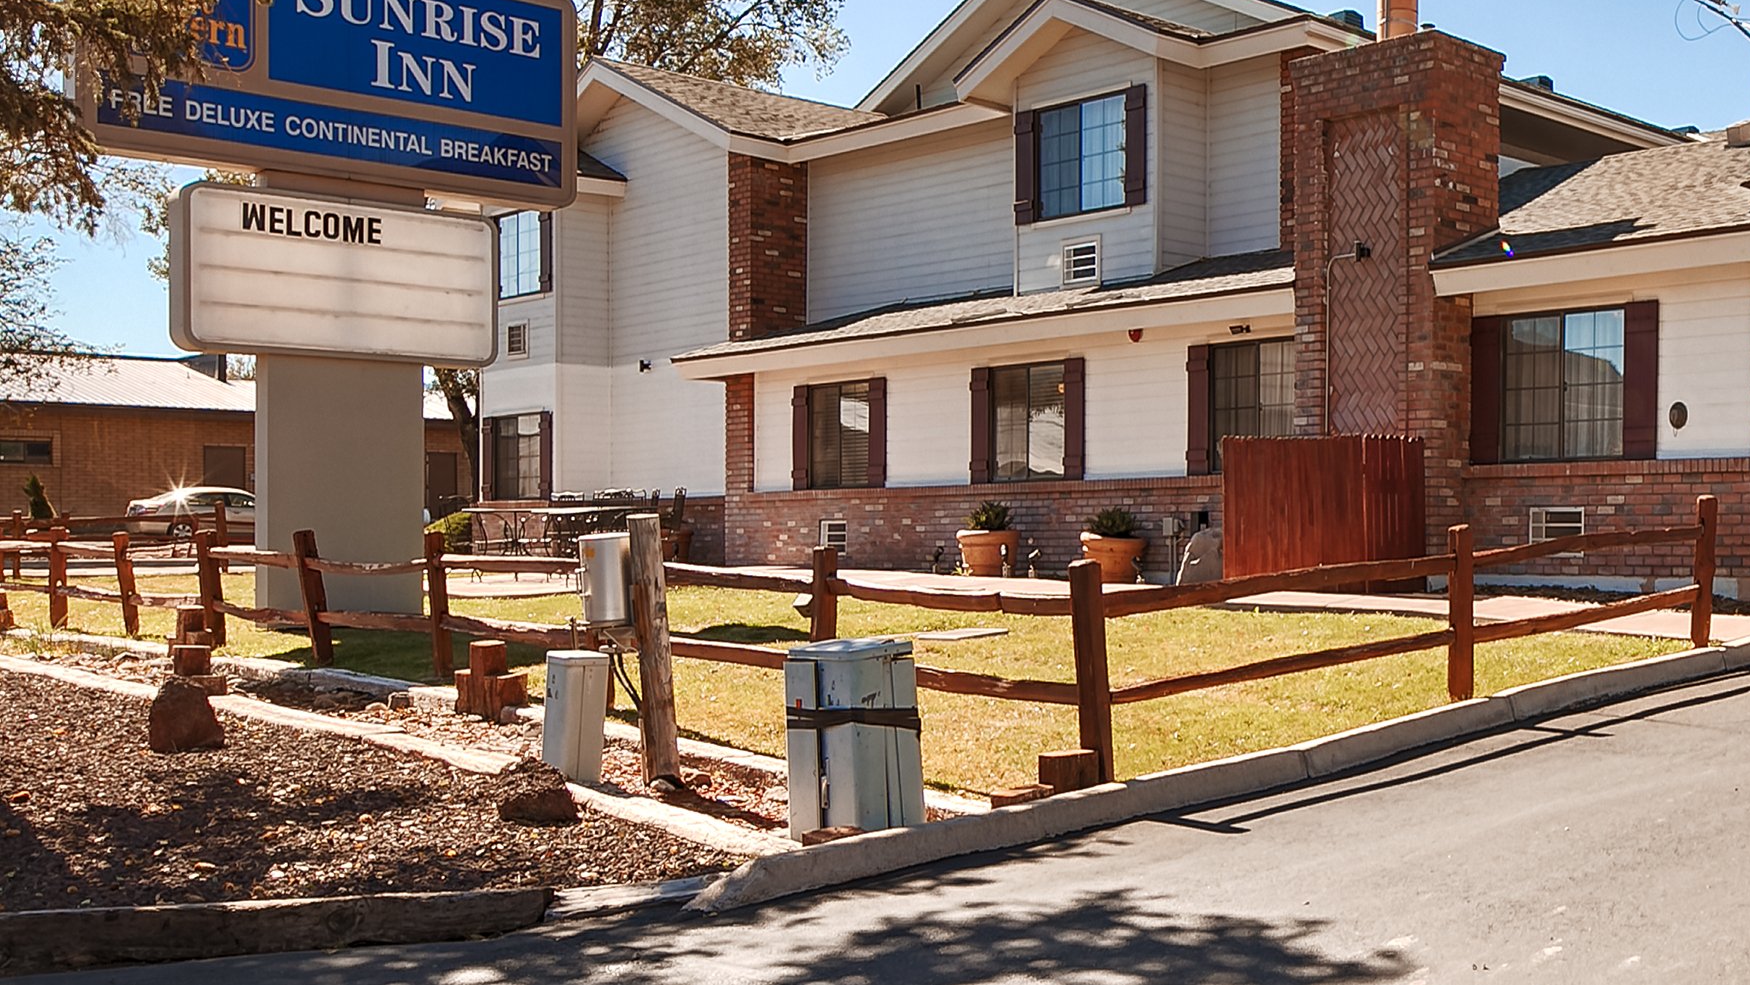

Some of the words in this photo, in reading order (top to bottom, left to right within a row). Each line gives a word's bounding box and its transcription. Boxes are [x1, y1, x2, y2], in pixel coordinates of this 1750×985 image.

[370, 39, 477, 103] INN
[185, 100, 275, 133] DELUXE
[285, 116, 432, 156] CONTINENTAL
[440, 138, 552, 173] BREAKFAST
[241, 202, 383, 244] WELCOME
